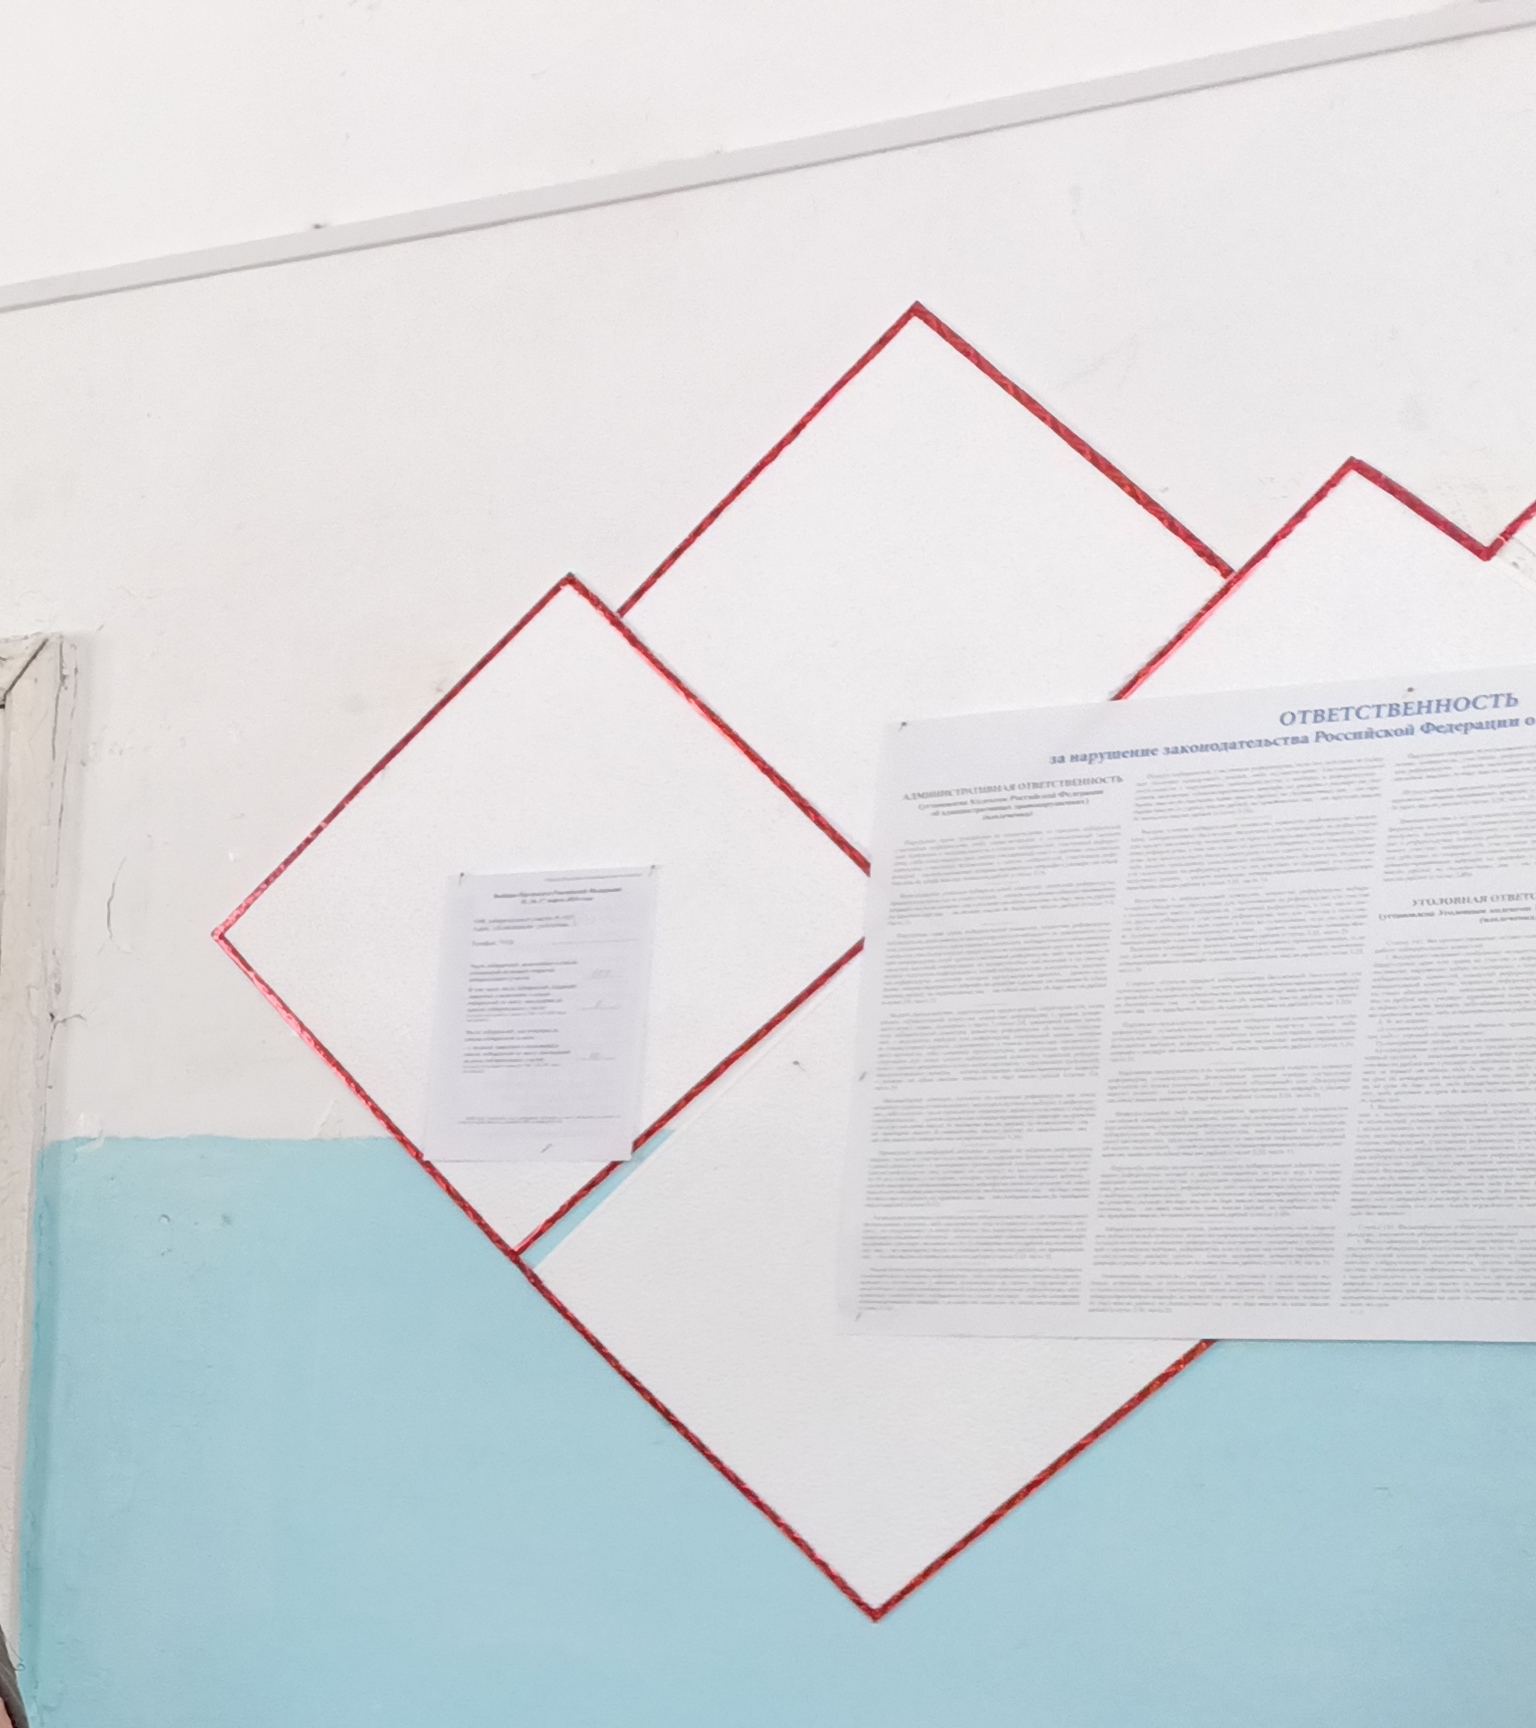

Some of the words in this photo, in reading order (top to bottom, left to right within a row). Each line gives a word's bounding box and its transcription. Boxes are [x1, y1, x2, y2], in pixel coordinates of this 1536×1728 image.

[1279, 692, 1520, 727] ОТВЕТСТВЕННОСТЬ
[1049, 754, 1066, 765] за
[1070, 746, 1159, 765] нарушение
[1162, 735, 1310, 757] законодательства
[1314, 724, 1416, 744] Российской
[1419, 717, 1520, 736] Федерации
